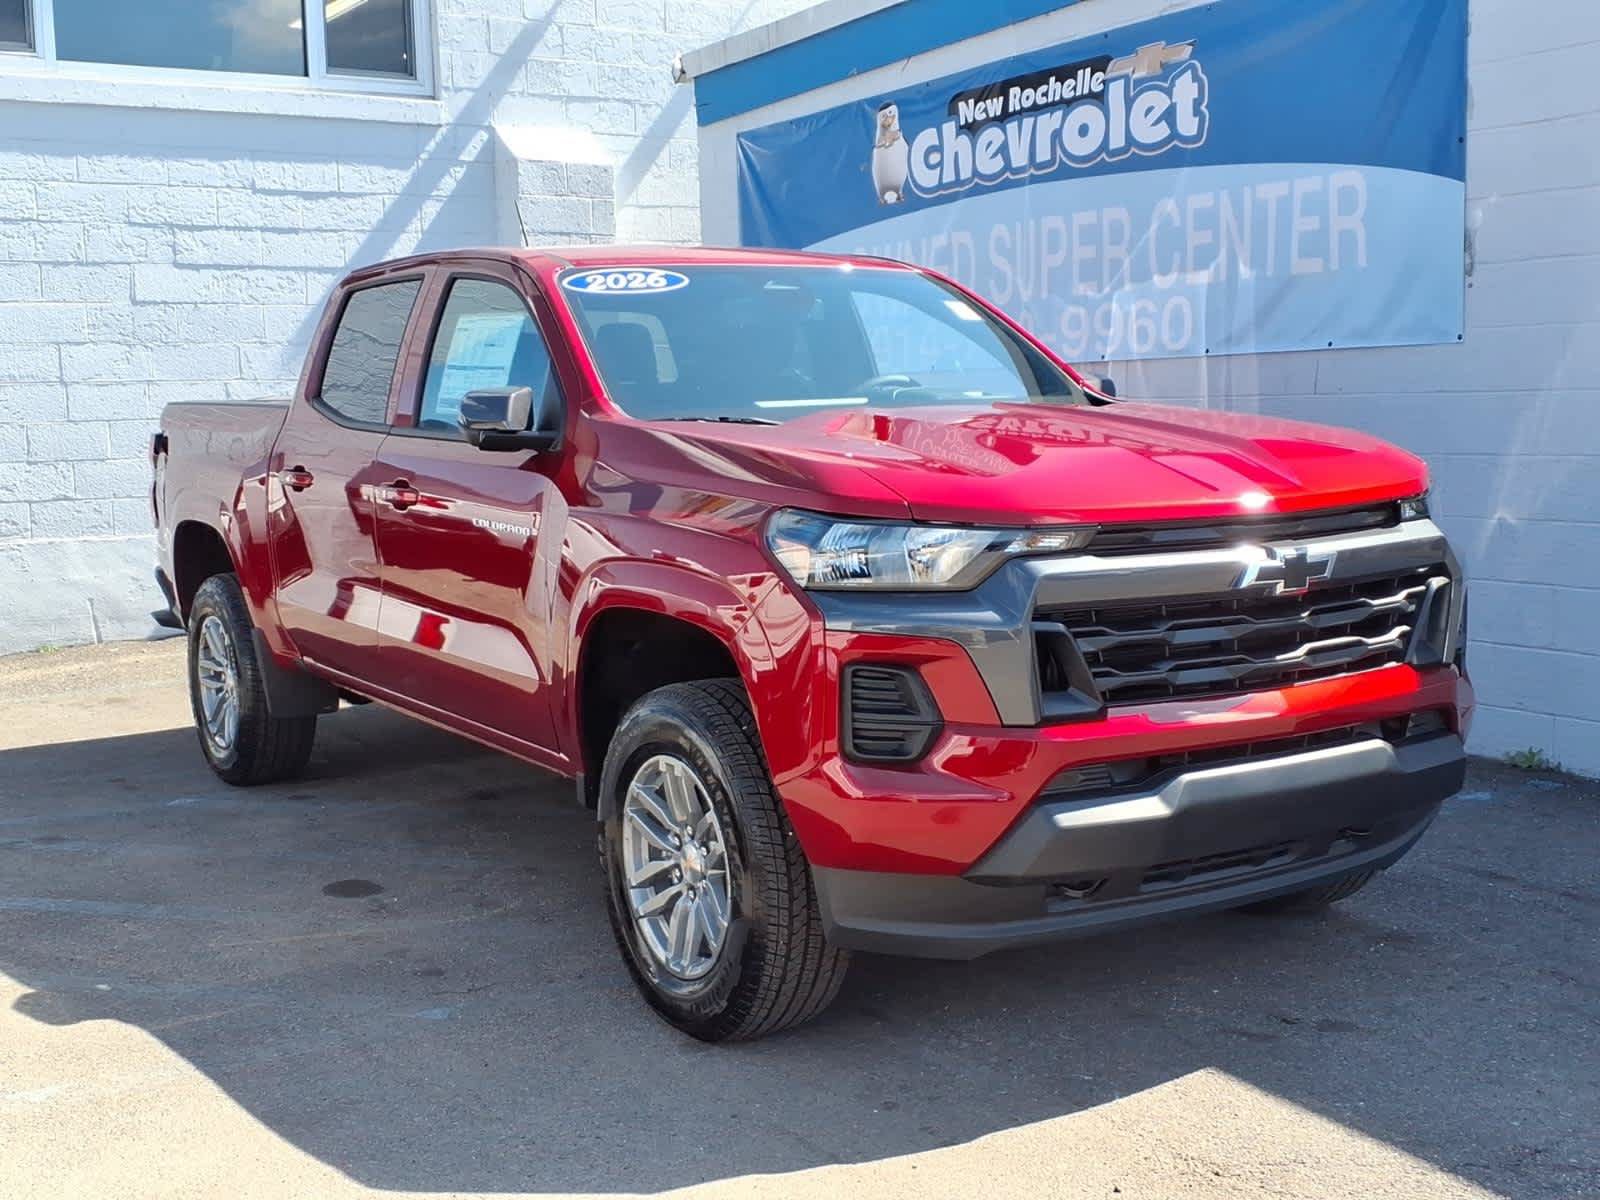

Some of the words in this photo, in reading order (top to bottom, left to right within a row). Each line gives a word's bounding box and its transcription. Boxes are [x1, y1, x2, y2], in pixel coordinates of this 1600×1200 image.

[957, 94, 1004, 127] New
[1008, 67, 1105, 112] Rochelle
[910, 70, 1199, 189] Chevrolet
[988, 207, 1132, 306] SUPER
[1151, 169, 1368, 289] CENTER
[584, 270, 668, 291] 2026
[471, 517, 531, 537] COLORADO
